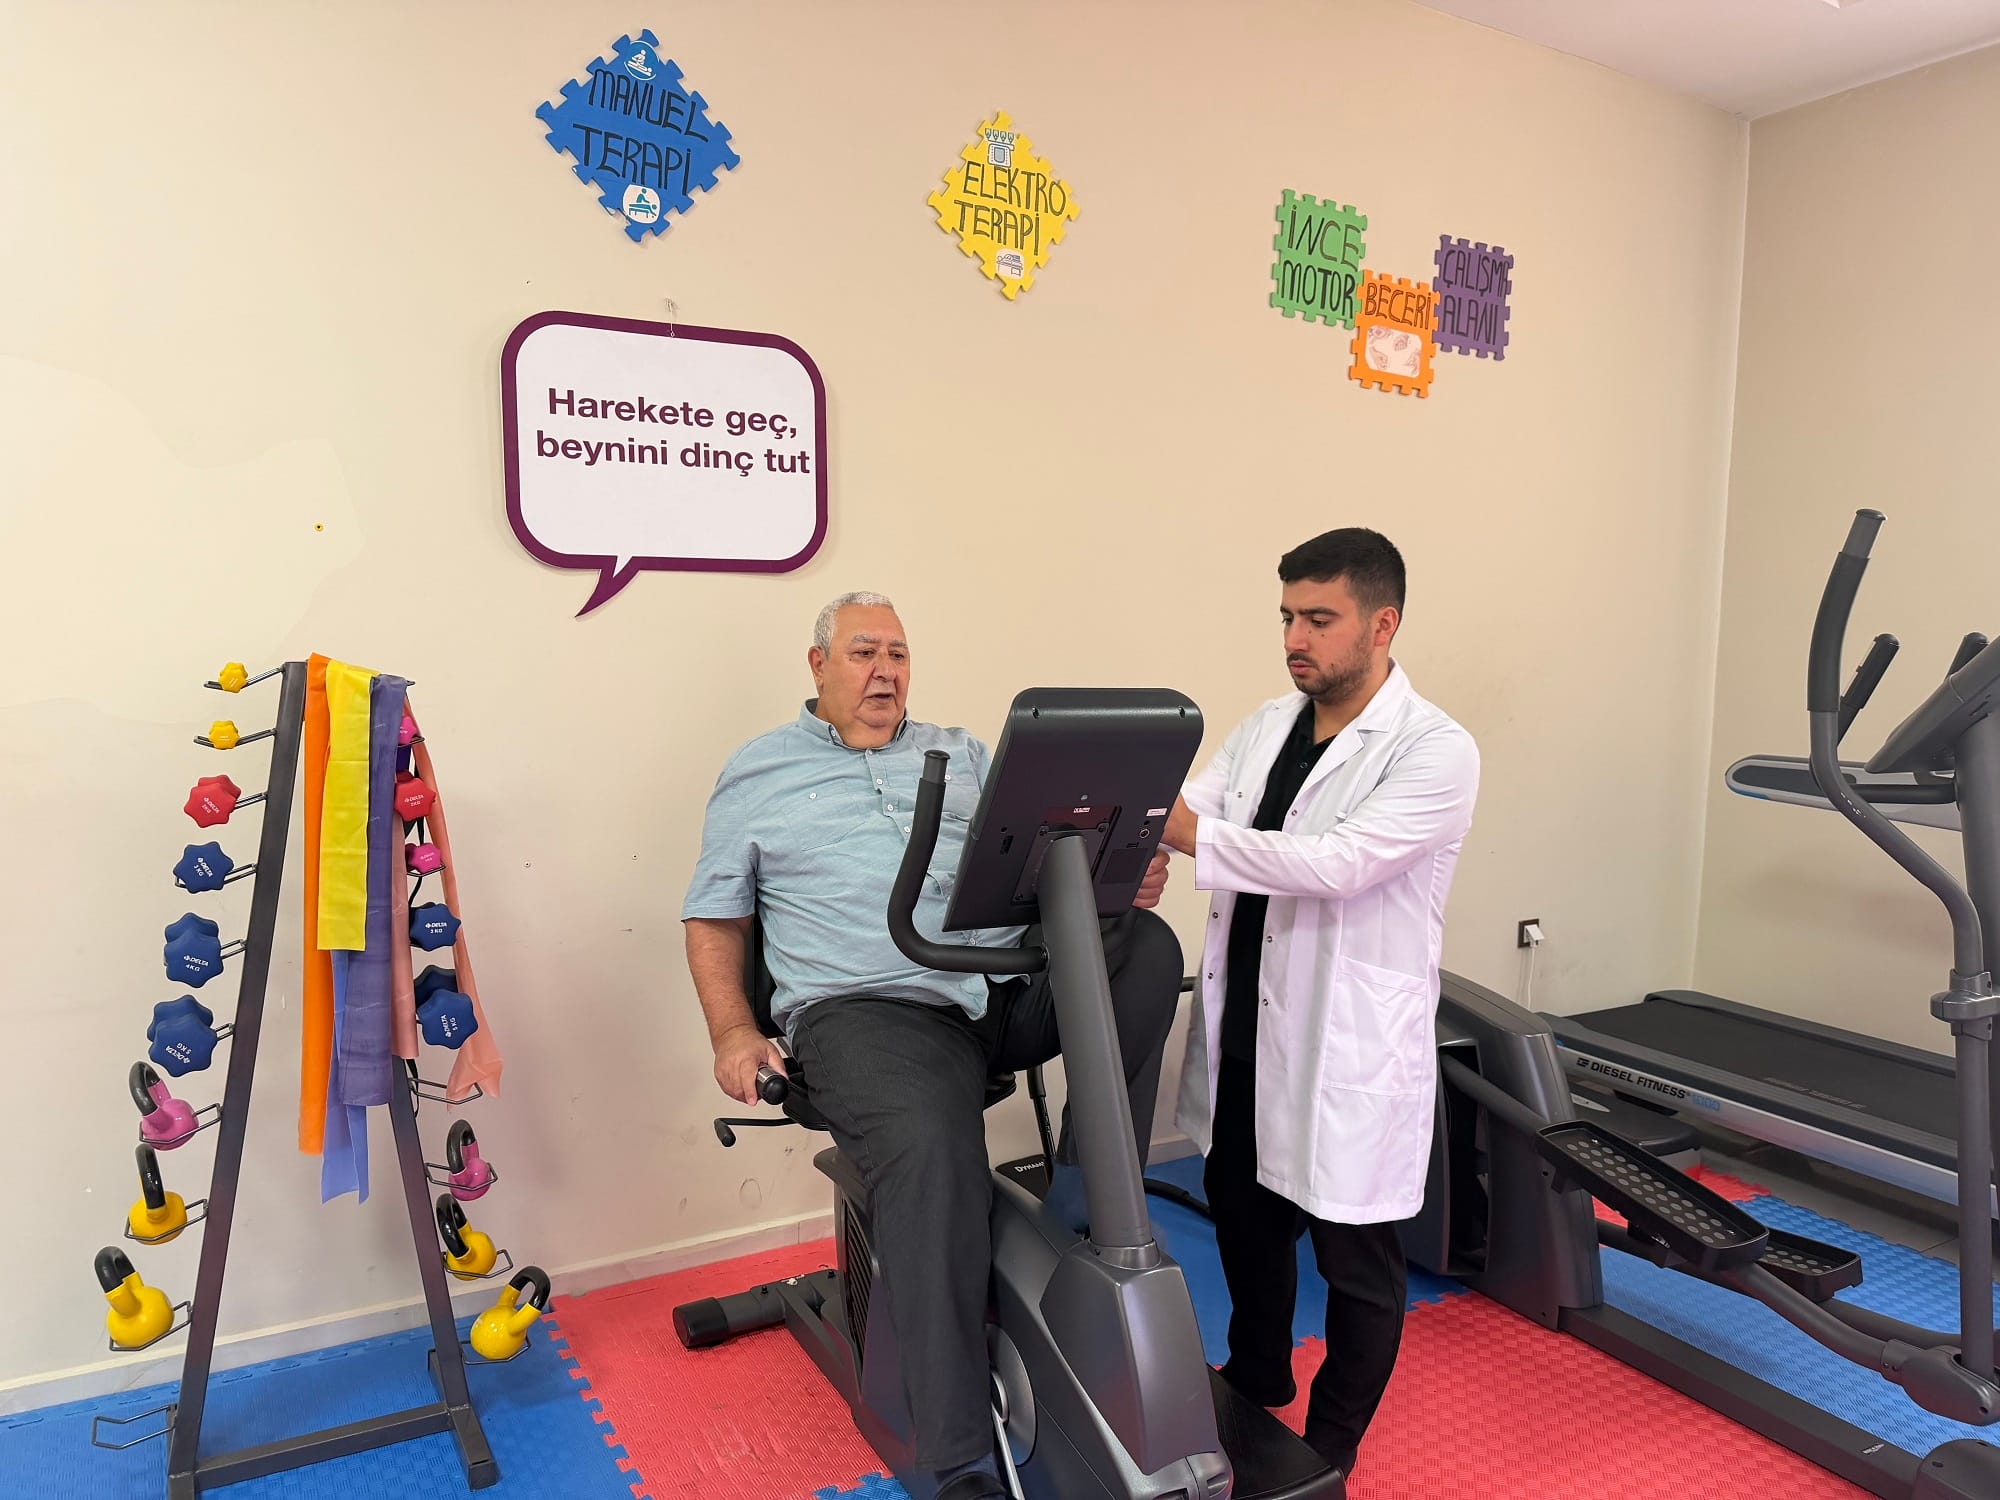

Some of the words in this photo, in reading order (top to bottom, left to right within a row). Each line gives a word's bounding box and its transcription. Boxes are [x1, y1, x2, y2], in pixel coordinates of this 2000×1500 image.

[588, 69, 709, 142] MANUEL
[963, 160, 1066, 216] ELEKTRO
[954, 200, 1040, 256] TERAPİ
[1288, 204, 1362, 272] İNCE
[1282, 260, 1357, 319] MOTOR
[1443, 250, 1509, 300] ÇALIŞMA
[1364, 282, 1432, 330] BECERİ
[1442, 295, 1498, 346] ALANI
[549, 388, 714, 428] Harekete
[725, 409, 797, 440] geç,
[537, 430, 668, 466] beynini
[680, 442, 754, 477] dinç
[764, 449, 811, 474] tut
[190, 957, 209, 967] DELTA
[166, 1045, 185, 1060] DELTA
[1591, 1062, 1634, 1083] DIESEL
[1636, 1076, 1687, 1099] FITNESS
